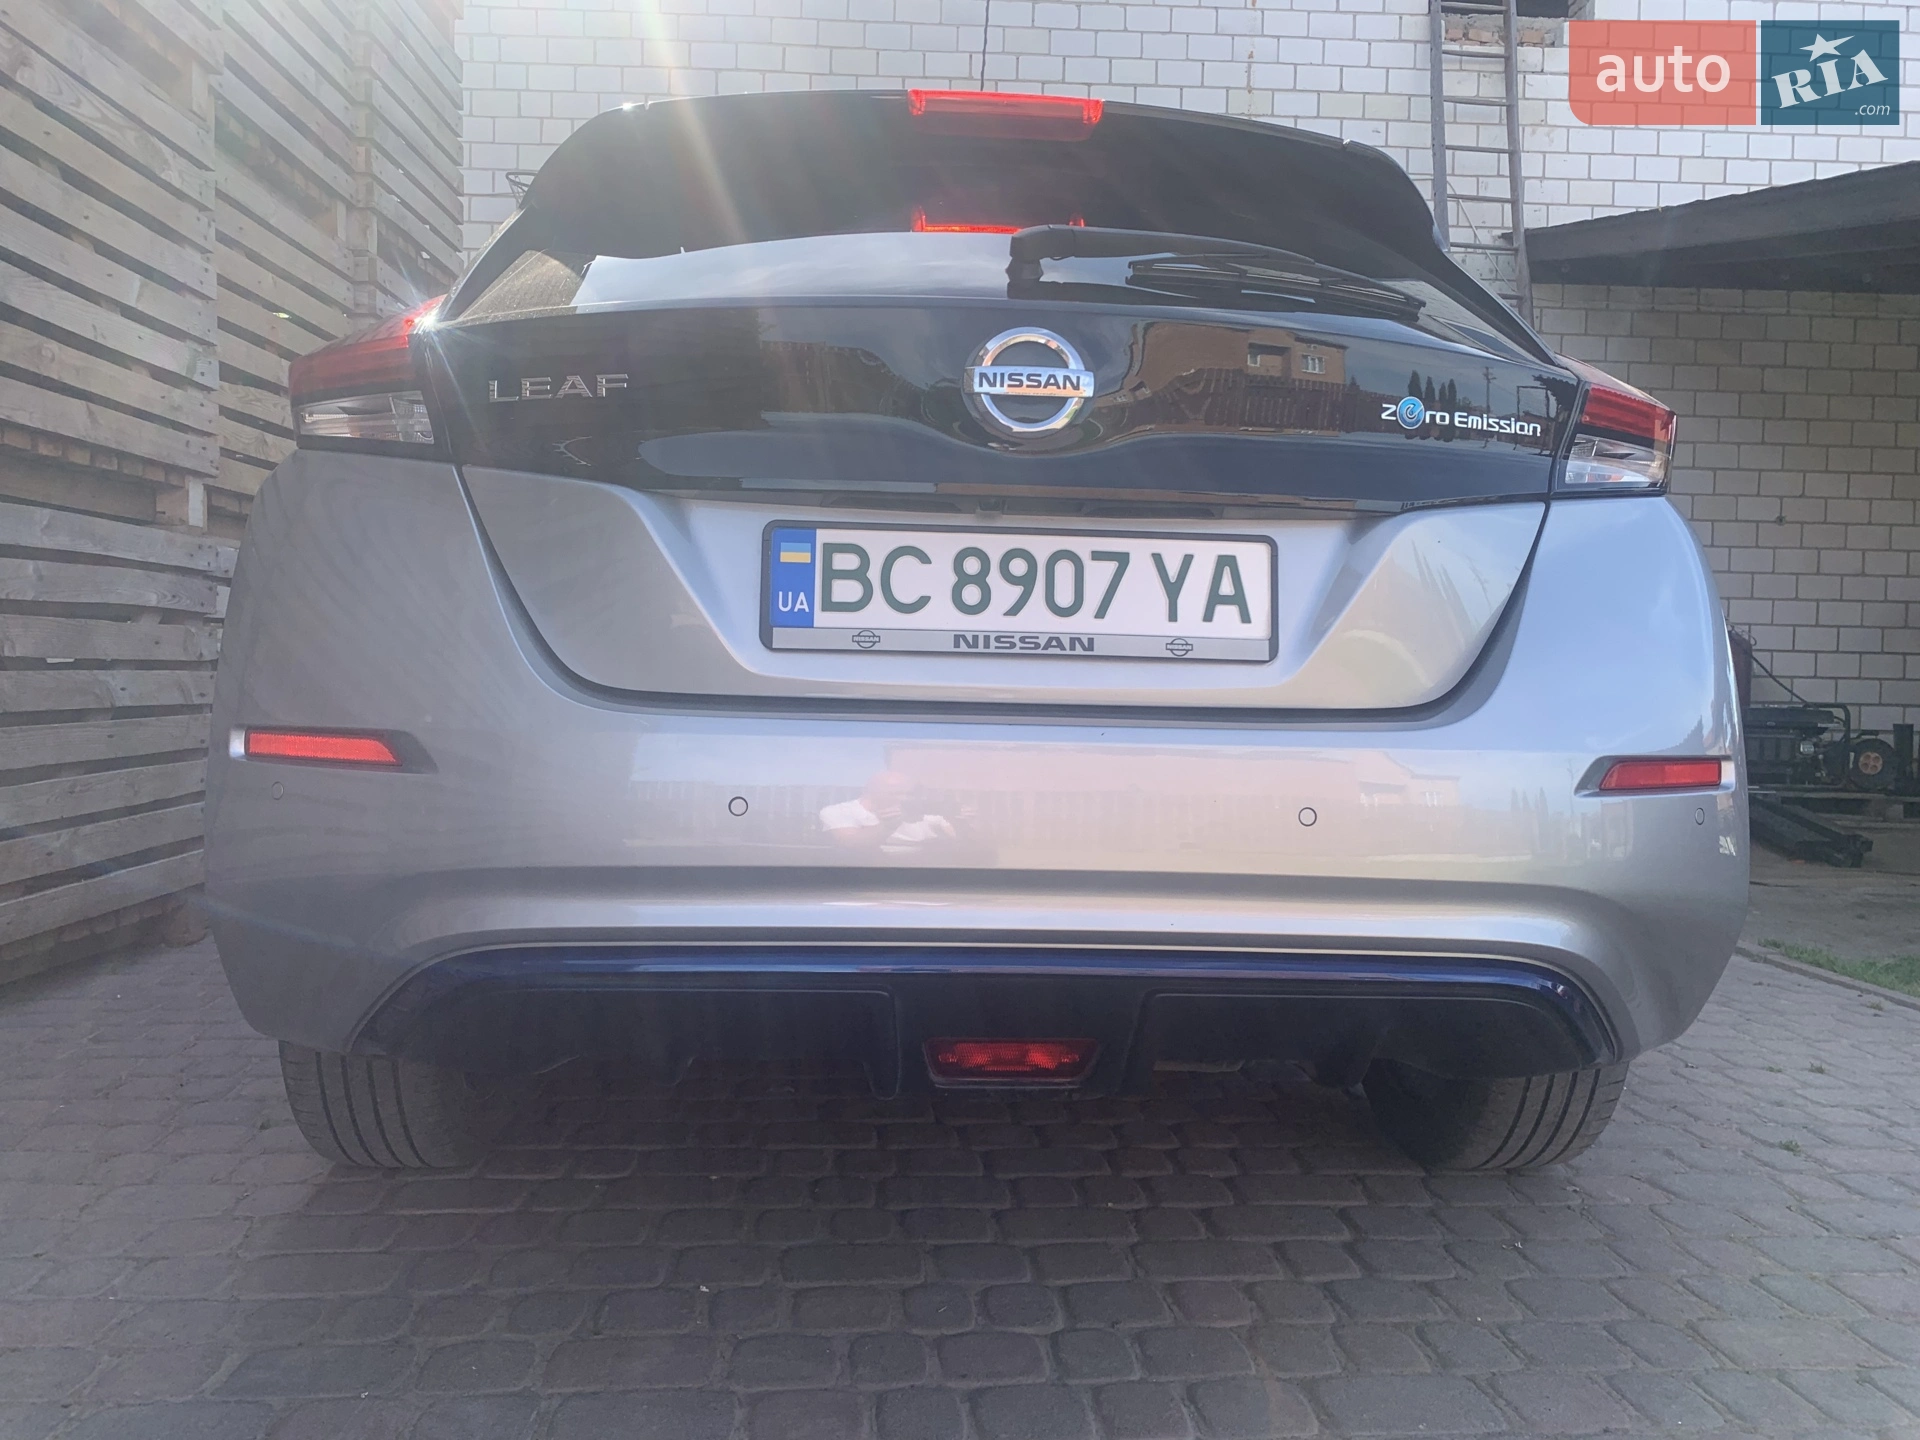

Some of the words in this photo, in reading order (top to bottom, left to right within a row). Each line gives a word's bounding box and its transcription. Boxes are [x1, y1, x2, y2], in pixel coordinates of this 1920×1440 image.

[488, 373, 629, 402] LEAF
[978, 371, 1081, 391] NISSAN
[1454, 411, 1541, 437] Emission
[820, 542, 933, 615] BC
[950, 546, 1131, 620] 8907
[1151, 552, 1252, 625] YA
[778, 591, 810, 613] UA
[953, 633, 1095, 652] NISSAN
